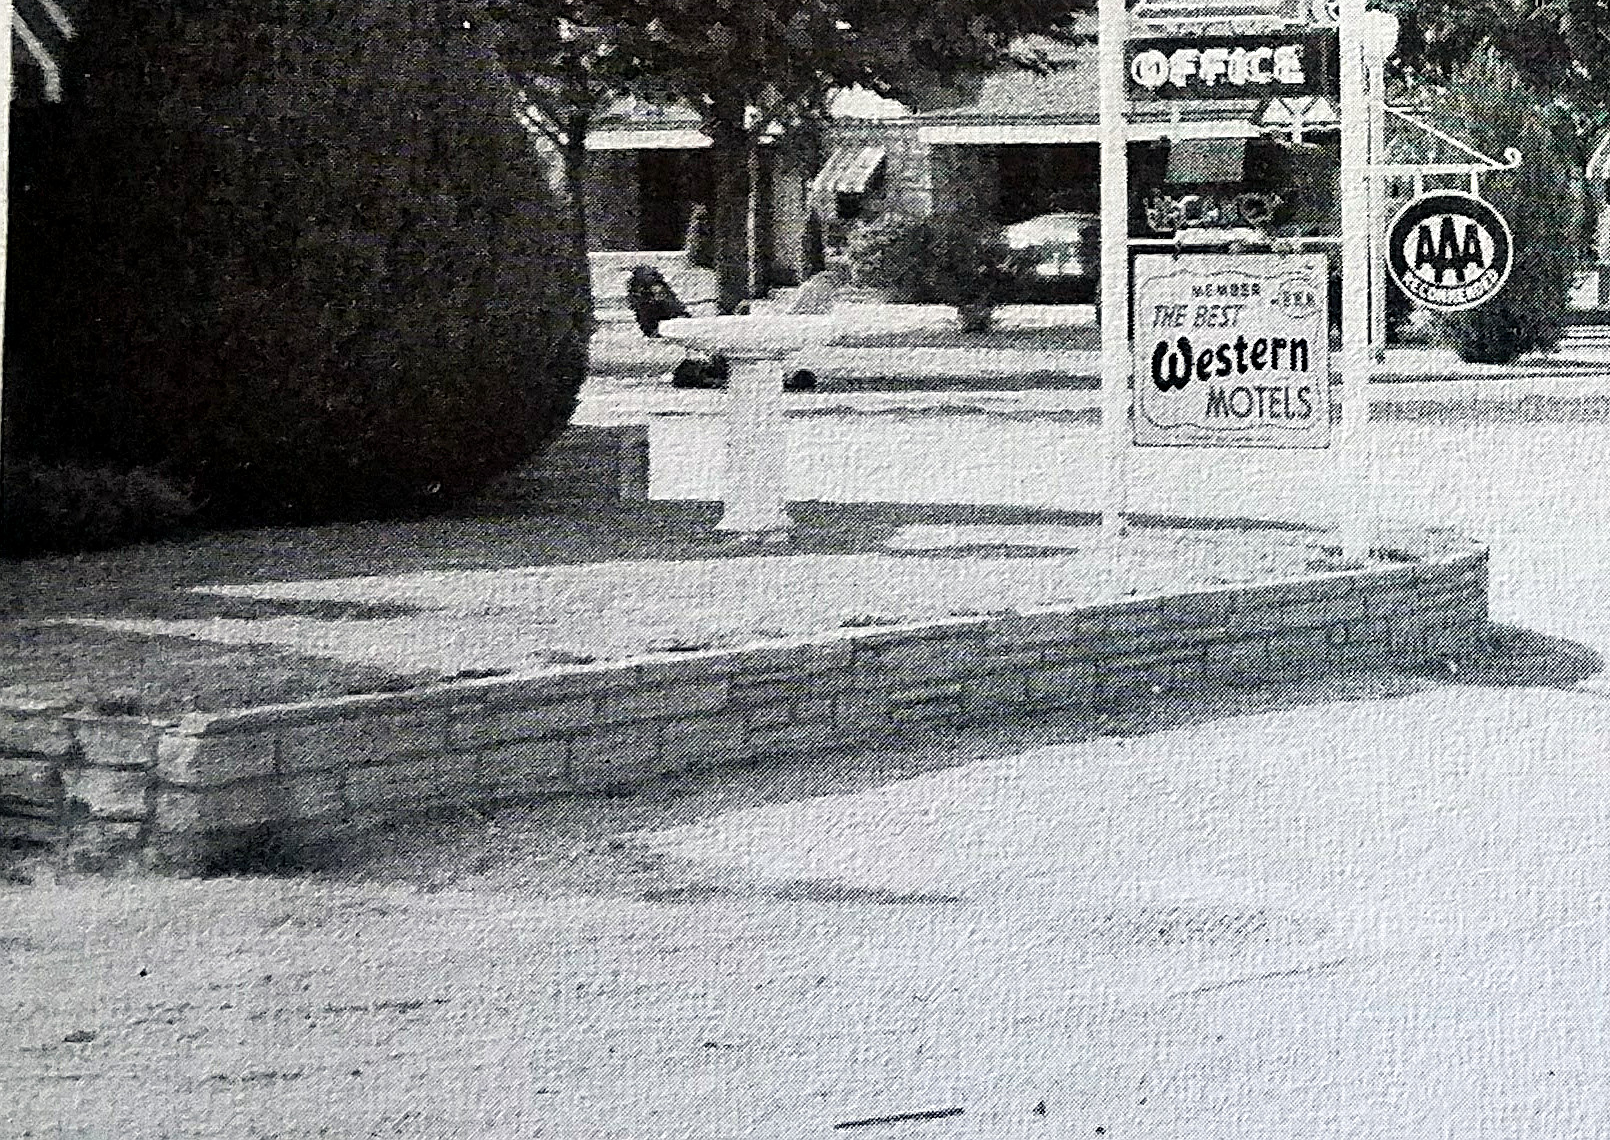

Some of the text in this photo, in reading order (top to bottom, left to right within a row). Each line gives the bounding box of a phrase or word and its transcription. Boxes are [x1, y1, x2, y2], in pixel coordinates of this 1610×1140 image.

[1131, 44, 1305, 88] OFFICE
[1415, 216, 1484, 282] AAA
[1191, 283, 1262, 297] MEMBER
[1152, 303, 1245, 328] THE BEST
[1151, 336, 1309, 392] Western
[1204, 385, 1313, 420] MOTELS
